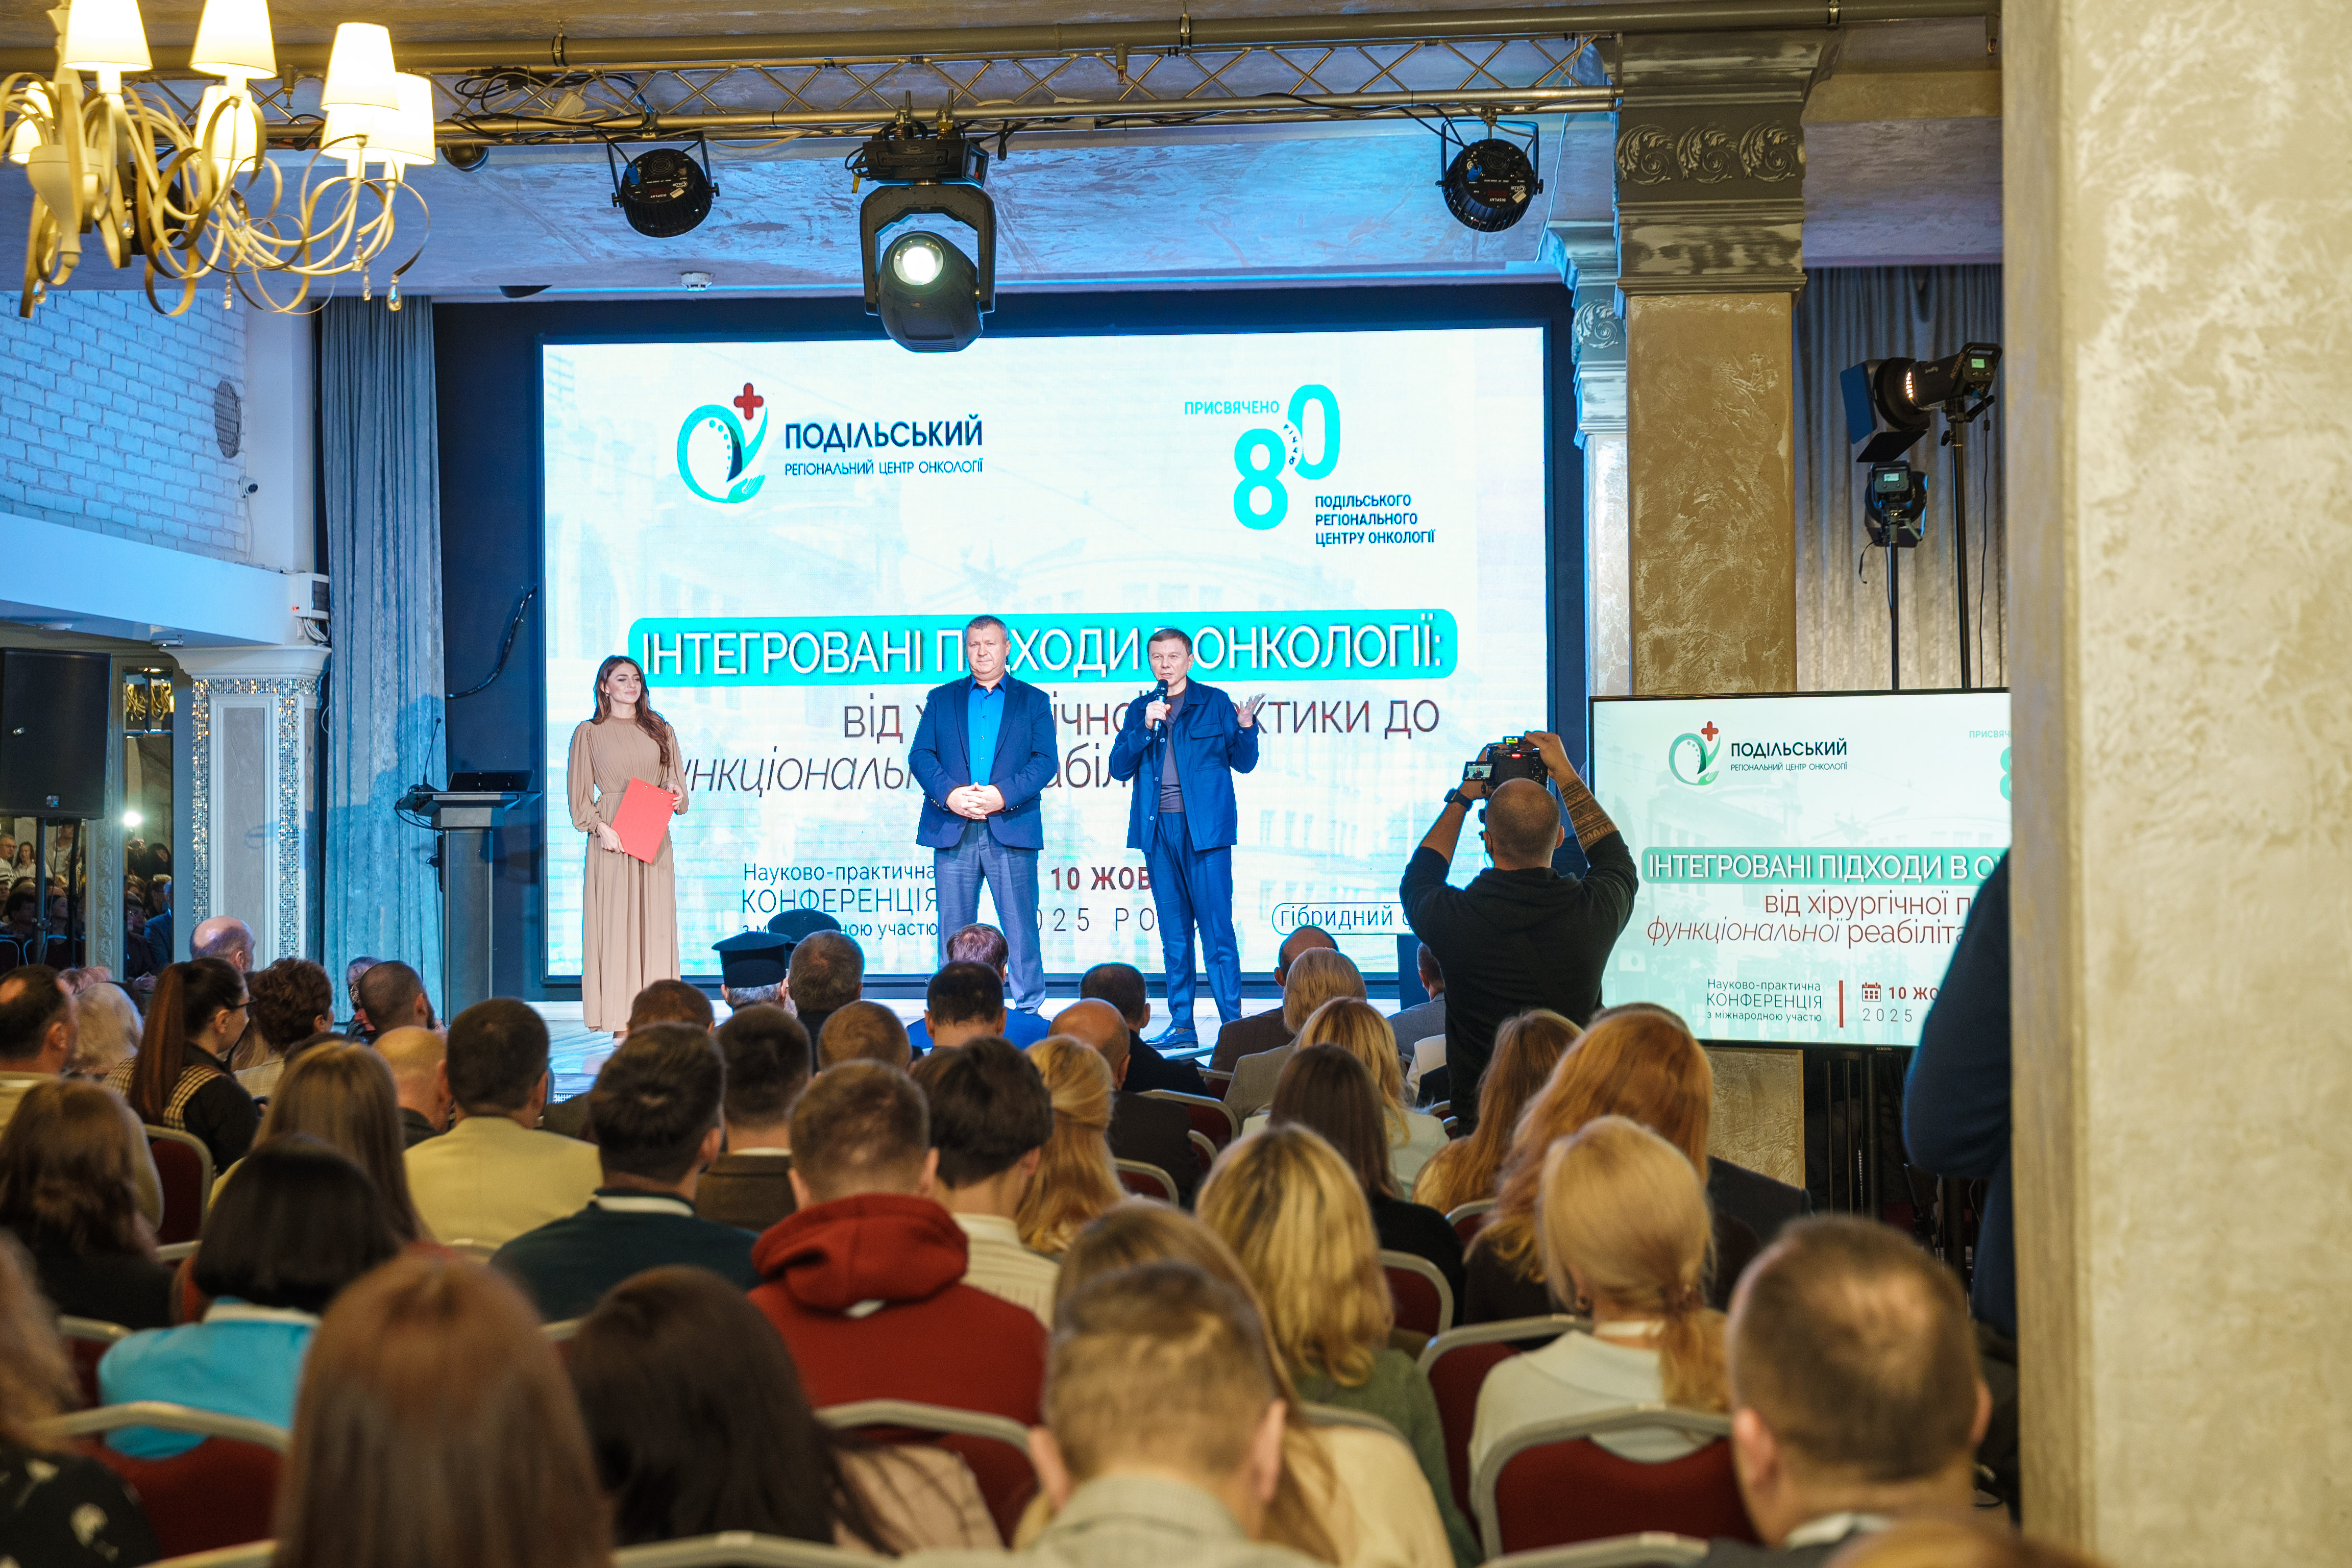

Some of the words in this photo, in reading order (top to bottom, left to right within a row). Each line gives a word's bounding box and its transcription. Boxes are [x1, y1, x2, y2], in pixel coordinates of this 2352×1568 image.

[1184, 400, 1279, 415] ПРИСВЯЧЕНО
[786, 414, 983, 453] ПОДІЛЬСЬКИЙ
[785, 459, 874, 476] РЕГІОНАЛЬНИЙ
[879, 461, 914, 475] ЦЕНТР
[919, 458, 984, 474] ОНКОЛОГІЇ
[1234, 384, 1340, 530] 80
[1315, 494, 1411, 510] ПОДІЛЬСЬКОГО
[1315, 512, 1418, 526] РЕГІОНАЛЬНОГО
[1315, 531, 1364, 547] ЦЕНТРУ
[1368, 528, 1435, 544] ОНКОЛОГІЇ
[643, 629, 921, 674] ІНТЕГРОВАНІ
[937, 627, 1138, 677] ПХОДИ
[1192, 614, 1441, 670] ОНКОЛОГІЇ:
[844, 693, 903, 744] від
[1232, 700, 1369, 734] ктики
[1385, 699, 1440, 740] до
[1731, 738, 1848, 759] ПОДІЛЬСЬКИЙ
[684, 745, 912, 797] нкціональ
[1731, 762, 1783, 772] РЕГІОНАЛЬНИЙ
[1786, 763, 1807, 771] ЦЕНТР
[1809, 761, 1848, 771] ОНКОЛОГІЇ
[745, 863, 935, 885] Науково-практична
[1051, 867, 1080, 890] 10
[1091, 867, 1150, 890] ЖОВ
[1649, 853, 1811, 878] ІНТЕГРОВАНІ
[1819, 854, 1942, 883] ПІДХОДИ
[1951, 855, 1967, 880] В
[743, 888, 937, 916] КОНФЕРЕНЦІЯ
[1766, 889, 1801, 917] від
[1808, 890, 1947, 920] хірургічної
[1036, 908, 1089, 932] 25
[1281, 904, 1392, 930] гібридний
[878, 923, 938, 940] участю
[1647, 916, 1840, 946] функціональної
[1708, 978, 1821, 993] Науково-практична
[1889, 986, 1906, 999] 10
[1706, 993, 1822, 1010] КОНФЕРЕНЦІЯ
[1715, 1010, 1783, 1022] міжнародною
[1786, 1013, 1822, 1022] участю
[1863, 1008, 1913, 1022] 2025
